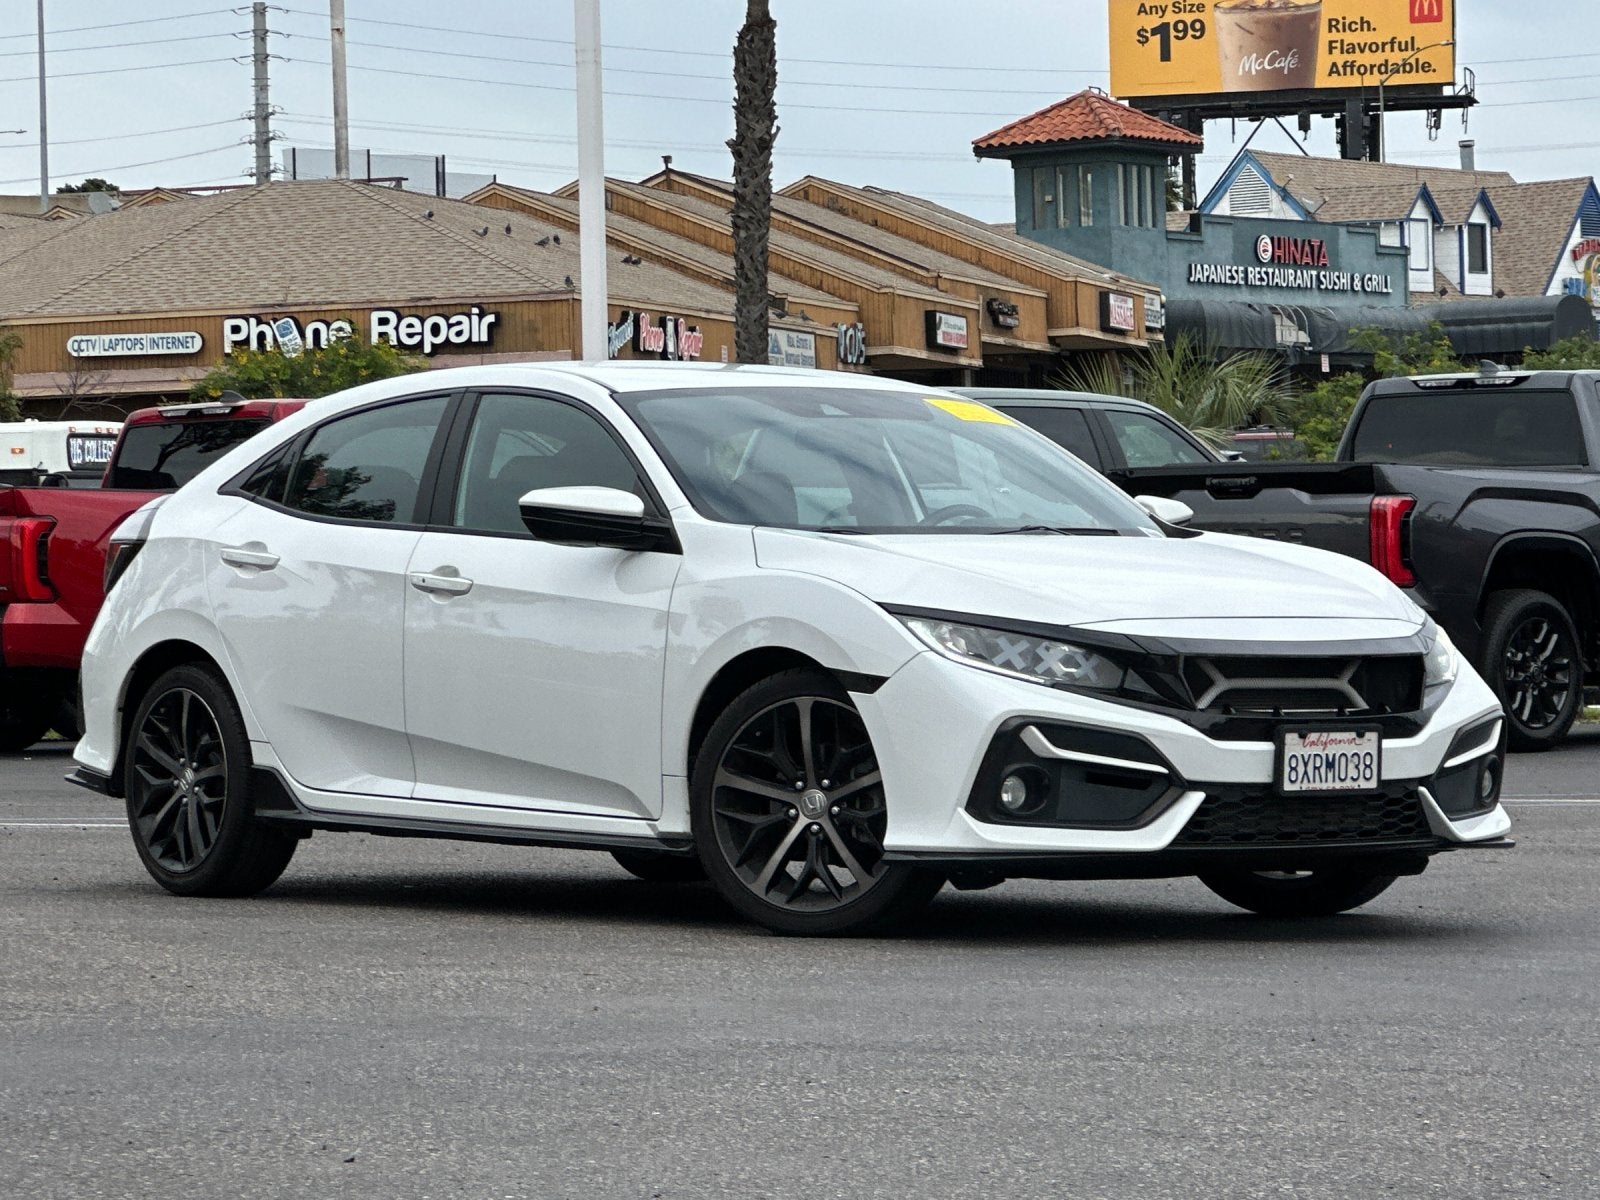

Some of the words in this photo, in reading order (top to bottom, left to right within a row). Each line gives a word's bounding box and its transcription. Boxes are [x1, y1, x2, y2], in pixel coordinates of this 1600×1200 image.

[1137, 3, 1168, 18] Any
[1172, 0, 1205, 14] Size
[1328, 16, 1376, 33] Rich.
[1328, 36, 1420, 54] Flavorful.
[1238, 49, 1299, 75] McCafé
[1328, 58, 1436, 76] Affordable.
[1273, 236, 1329, 266] HINATA
[1189, 263, 1245, 285] JAPANESE
[1247, 266, 1317, 288] RESTAURANT
[1320, 271, 1350, 290] SUSHI
[1353, 273, 1361, 291] &
[1364, 273, 1393, 293] GRILL
[371, 307, 495, 354] Repair
[71, 339, 97, 353] CCTV
[102, 337, 144, 352] LAPTOPS
[149, 335, 196, 350] INTERNET
[1303, 732, 1362, 752] California
[1288, 751, 1373, 784] 8XRM038
